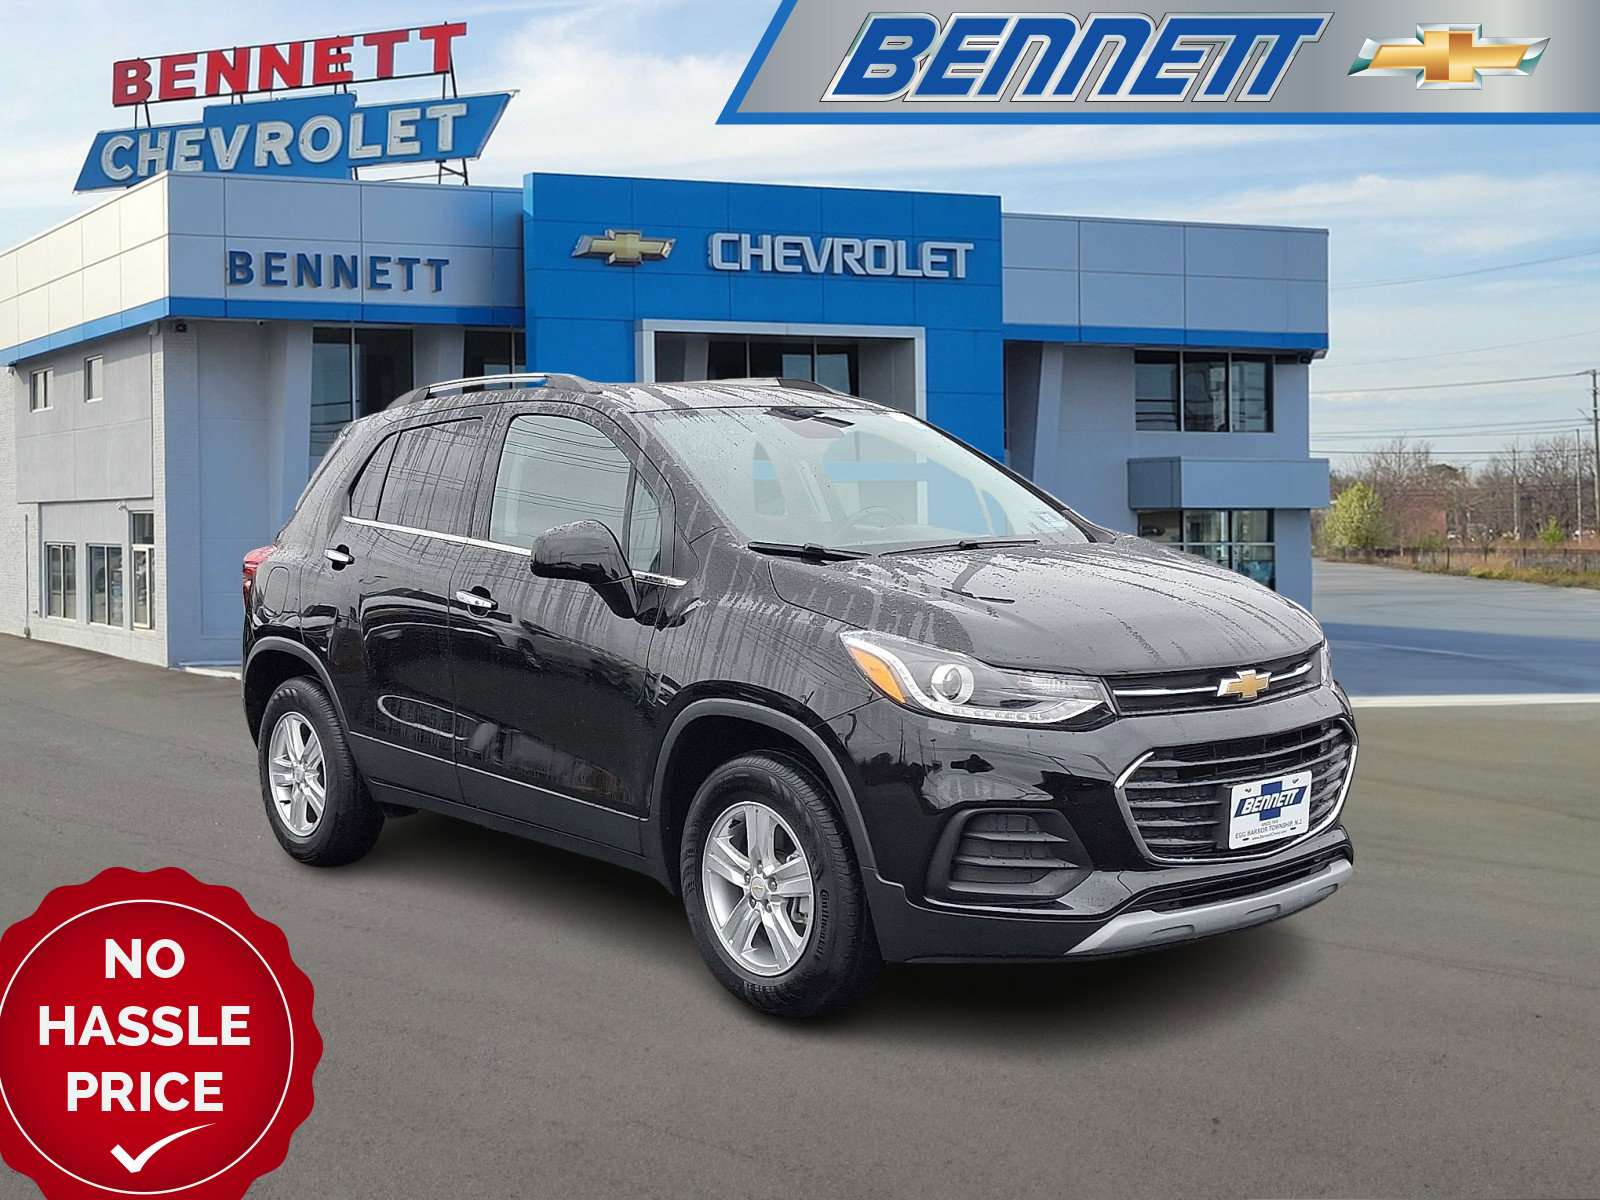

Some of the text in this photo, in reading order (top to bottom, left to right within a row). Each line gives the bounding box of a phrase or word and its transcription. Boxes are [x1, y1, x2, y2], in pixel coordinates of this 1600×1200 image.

[113, 23, 467, 106] BENNETT
[100, 103, 468, 181] CHEVROLET
[226, 250, 450, 292] BENNETT
[708, 232, 974, 278] CHEVROLET
[1241, 788, 1300, 815] BENNETT
[1235, 831, 1246, 840] EGG
[1247, 826, 1268, 836] HARBOR
